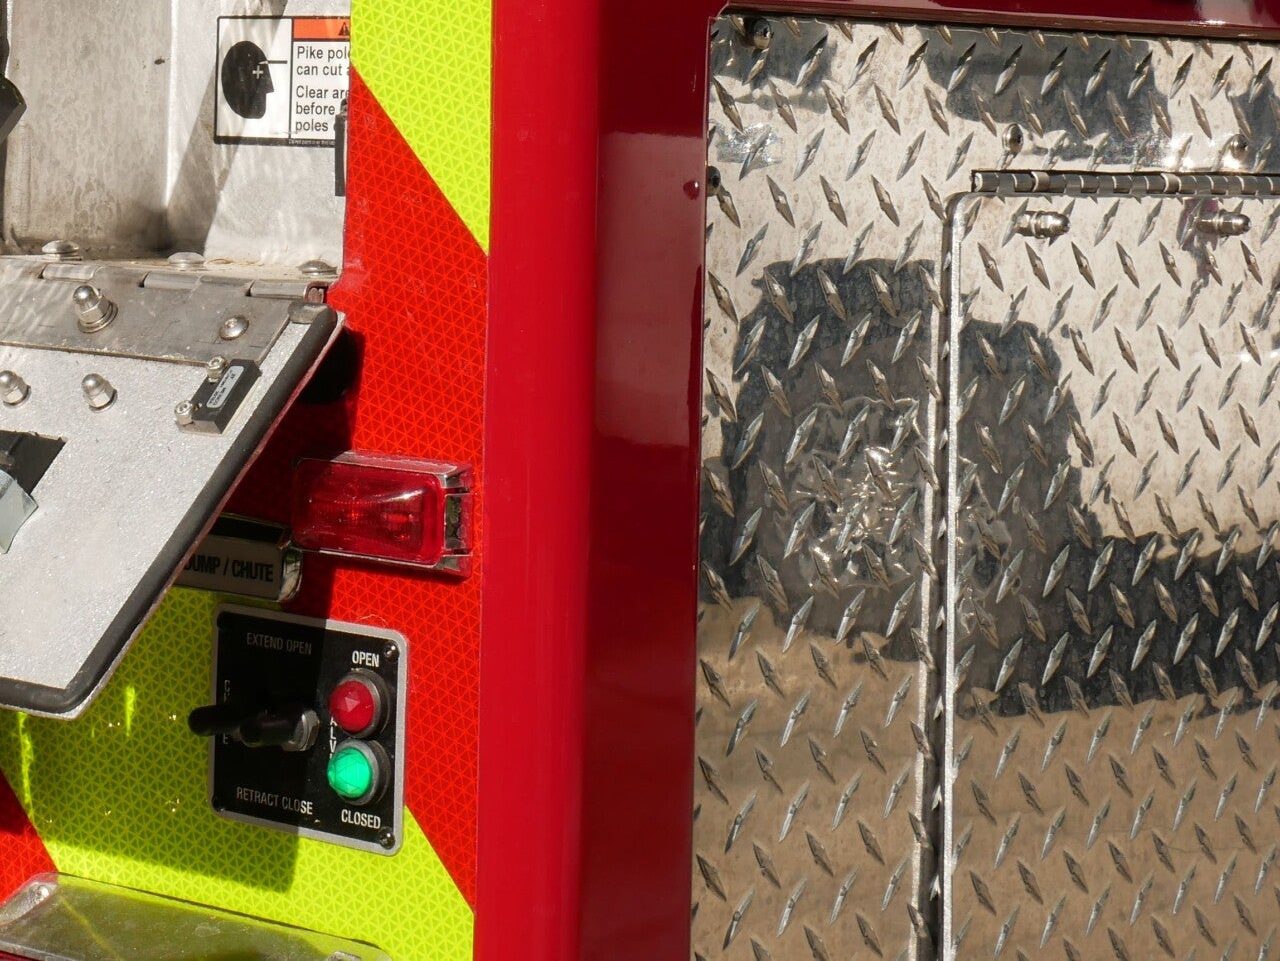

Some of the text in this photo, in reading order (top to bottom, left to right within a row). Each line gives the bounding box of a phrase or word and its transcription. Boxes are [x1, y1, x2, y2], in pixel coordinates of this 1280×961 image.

[297, 46, 323, 59] Pike
[296, 65, 319, 76] can
[322, 63, 343, 76] cut
[295, 85, 329, 99] Clear
[295, 102, 336, 116] before
[295, 119, 329, 134] poles
[231, 559, 274, 582] CHUTE
[246, 632, 313, 656] EXTEND OPEN
[351, 650, 380, 668] OPEN
[236, 786, 314, 816] RETRACT CLOSE
[340, 808, 381, 830] CLOSED
